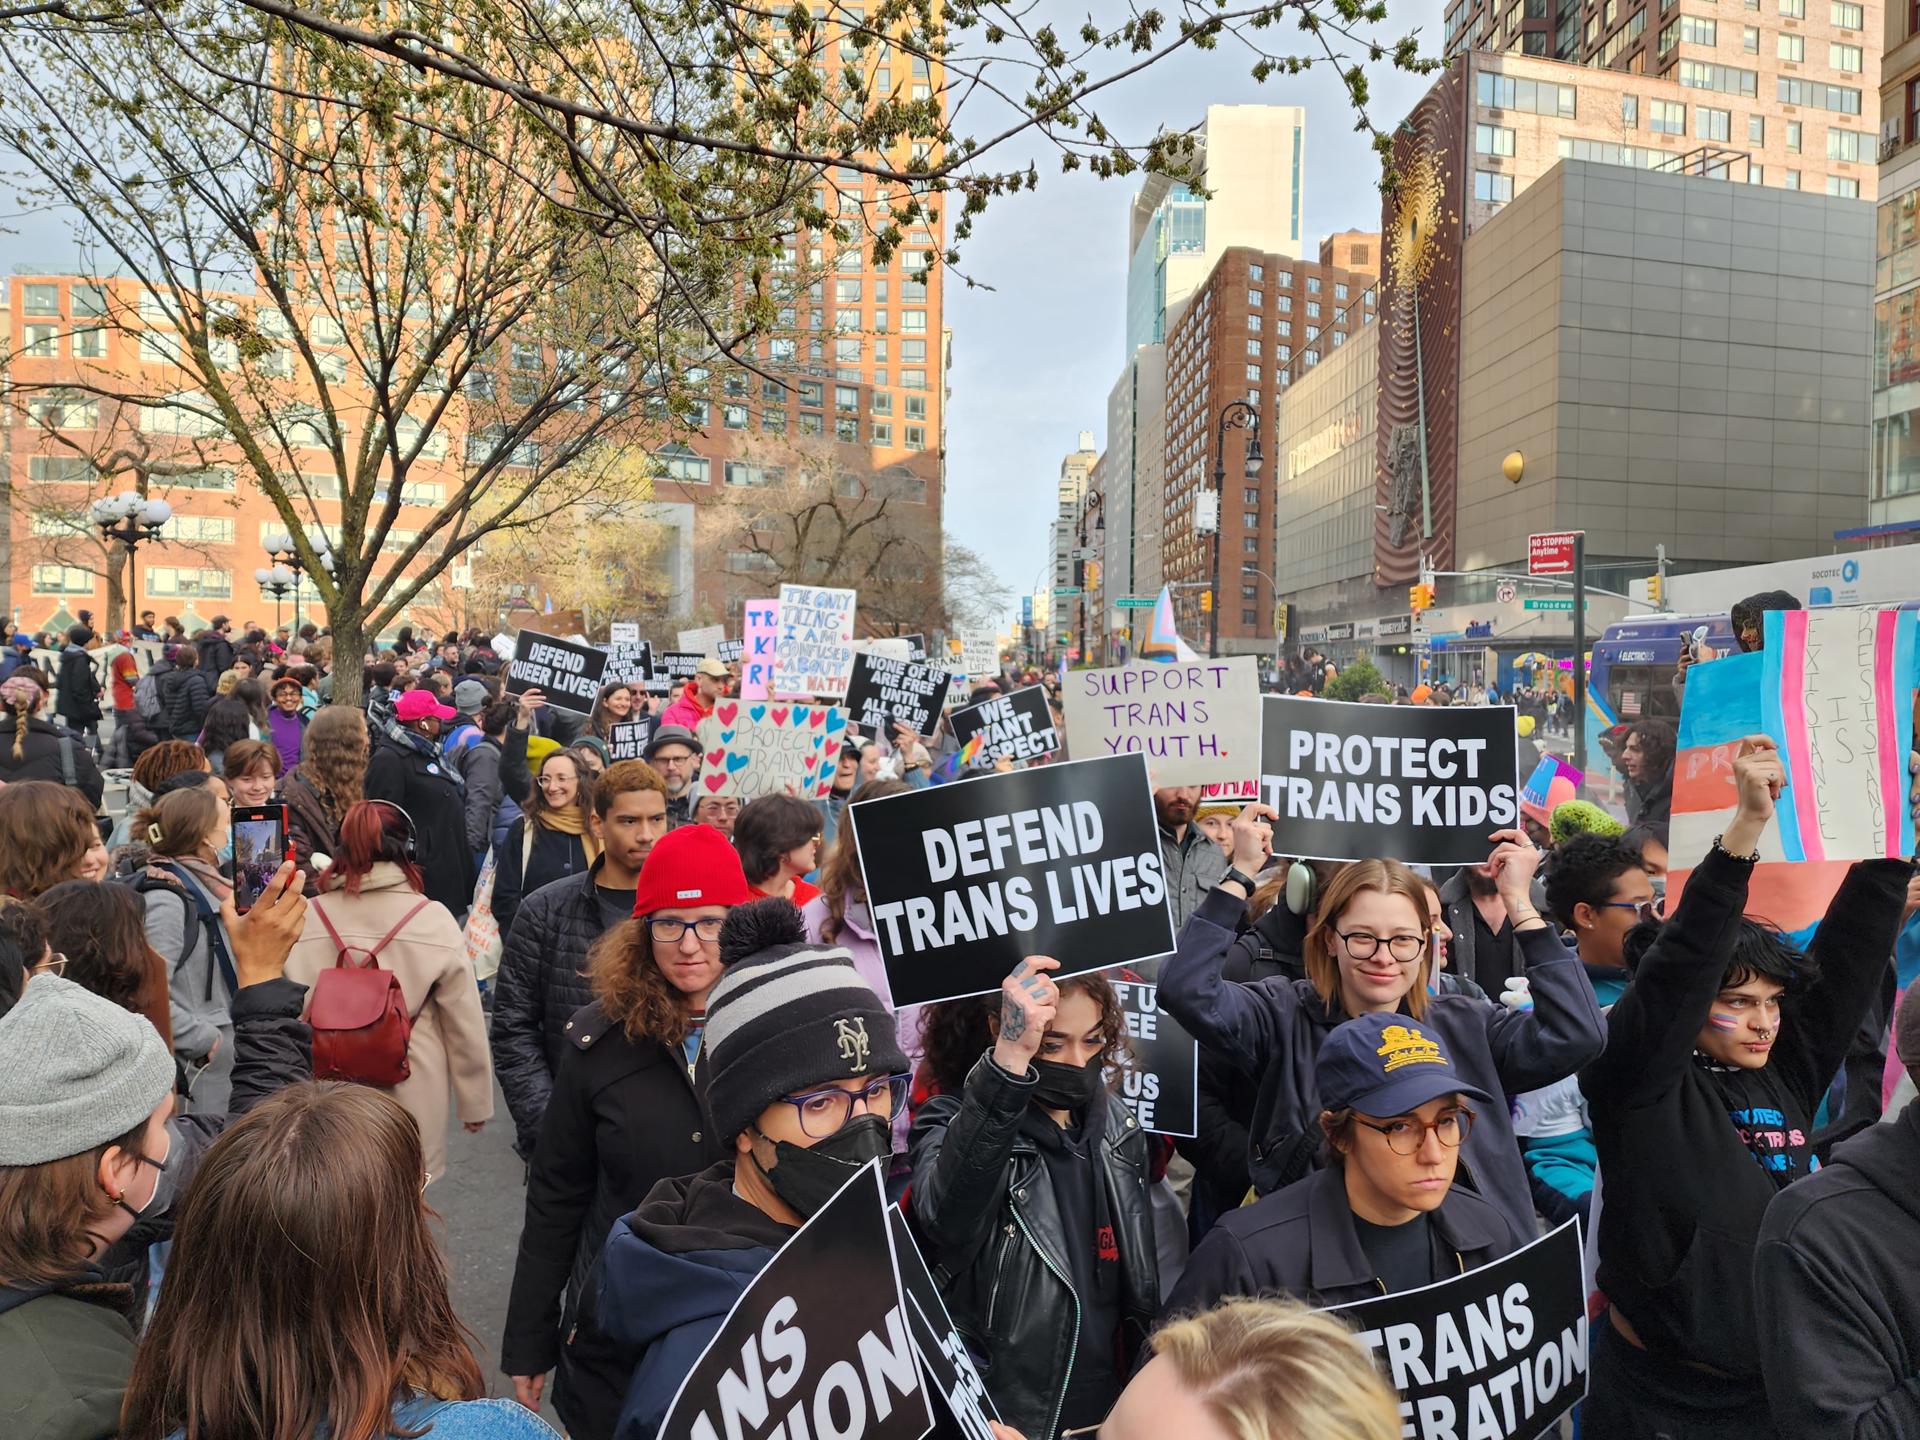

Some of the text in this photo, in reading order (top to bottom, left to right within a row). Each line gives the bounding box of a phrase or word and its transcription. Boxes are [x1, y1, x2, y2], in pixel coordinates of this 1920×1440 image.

[1531, 536, 1574, 547] NO STOPPING
[1532, 547, 1559, 557] Anytime
[1812, 569, 1840, 579] SOCOTEC
[784, 587, 853, 611] THE ONLY
[1532, 600, 1572, 609] Broadwa
[782, 606, 840, 629] THING
[633, 643, 645, 651] US
[784, 624, 837, 645] I AM
[528, 643, 585, 673] DEFEND
[619, 651, 641, 660] FREE
[664, 656, 678, 665] OUR
[778, 640, 850, 662] CONFUSED
[603, 666, 645, 679] ALL OF US
[610, 660, 635, 670] UNTIL
[677, 666, 697, 675] PRIVA
[783, 657, 845, 675] ABOUT
[865, 656, 945, 685] NONE OF US
[510, 659, 599, 700] QUEER LIVES
[776, 675, 848, 692] IS MATH
[870, 670, 936, 696] ARE FREE
[1084, 667, 1229, 697] SUPPORT
[862, 697, 929, 722] ALL OF US
[880, 686, 921, 708] UNTIL
[861, 712, 886, 728] AR
[978, 697, 1015, 725] WE
[1104, 700, 1209, 728] TRANS
[615, 725, 633, 742] WE
[736, 716, 813, 751] PROTECT
[1827, 696, 1854, 764] IS
[1858, 611, 1885, 855] RESISTANCE
[974, 727, 1056, 769] ESPECT
[1289, 730, 1487, 779] PROTECT
[744, 748, 805, 775] TRANS
[1262, 774, 1401, 825] TRANS
[1411, 783, 1517, 827] KIDS
[921, 800, 1104, 883] DEFEND
[874, 852, 1165, 956] TRANS LIVES
[1114, 984, 1130, 1006] F
[1124, 1011, 1157, 1040] EE
[1123, 1070, 1160, 1101] US
[1351, 1282, 1535, 1390] TRANS
[1397, 1315, 1586, 1440] ERATION
